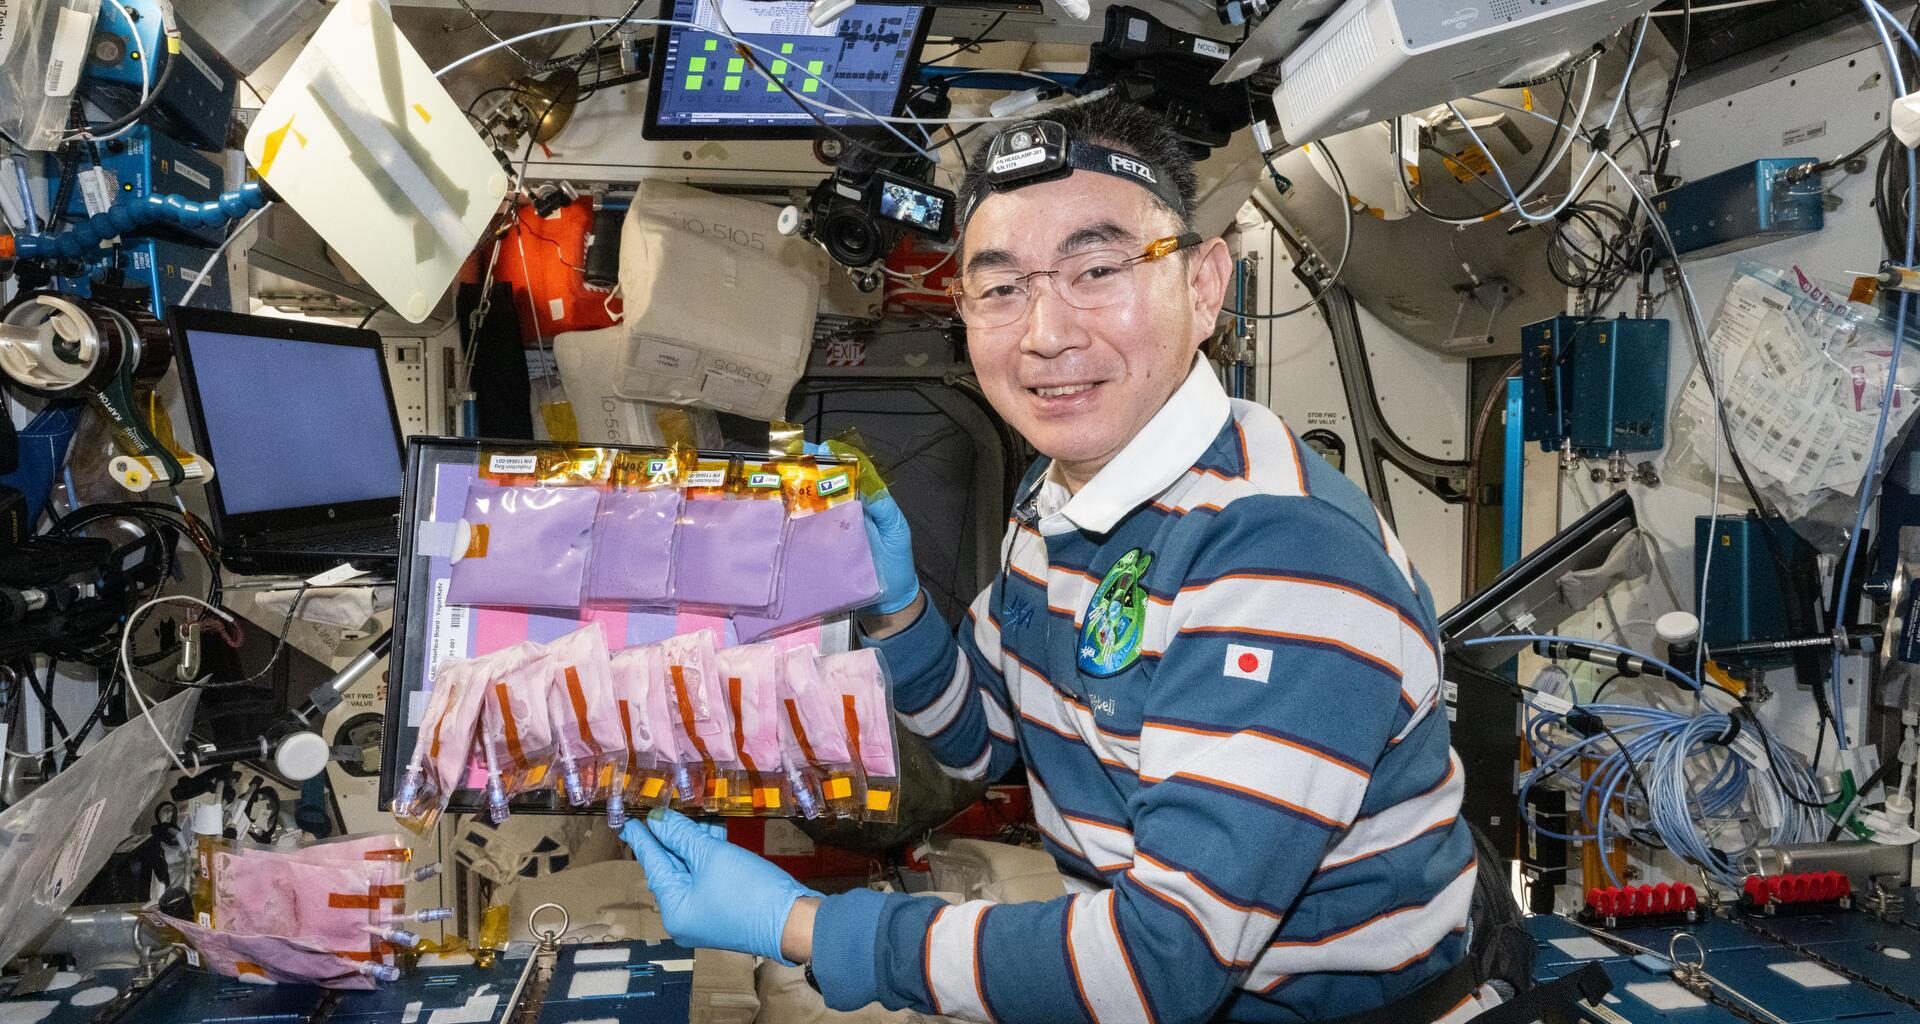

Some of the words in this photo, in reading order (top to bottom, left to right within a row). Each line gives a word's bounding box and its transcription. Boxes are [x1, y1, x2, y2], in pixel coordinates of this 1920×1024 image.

[1111, 154, 1158, 184] PETZL
[832, 343, 861, 359] EXIT
[97, 391, 122, 422] KAPTON
[433, 620, 441, 638] Board
[1773, 637, 1831, 649] Manfrotto
